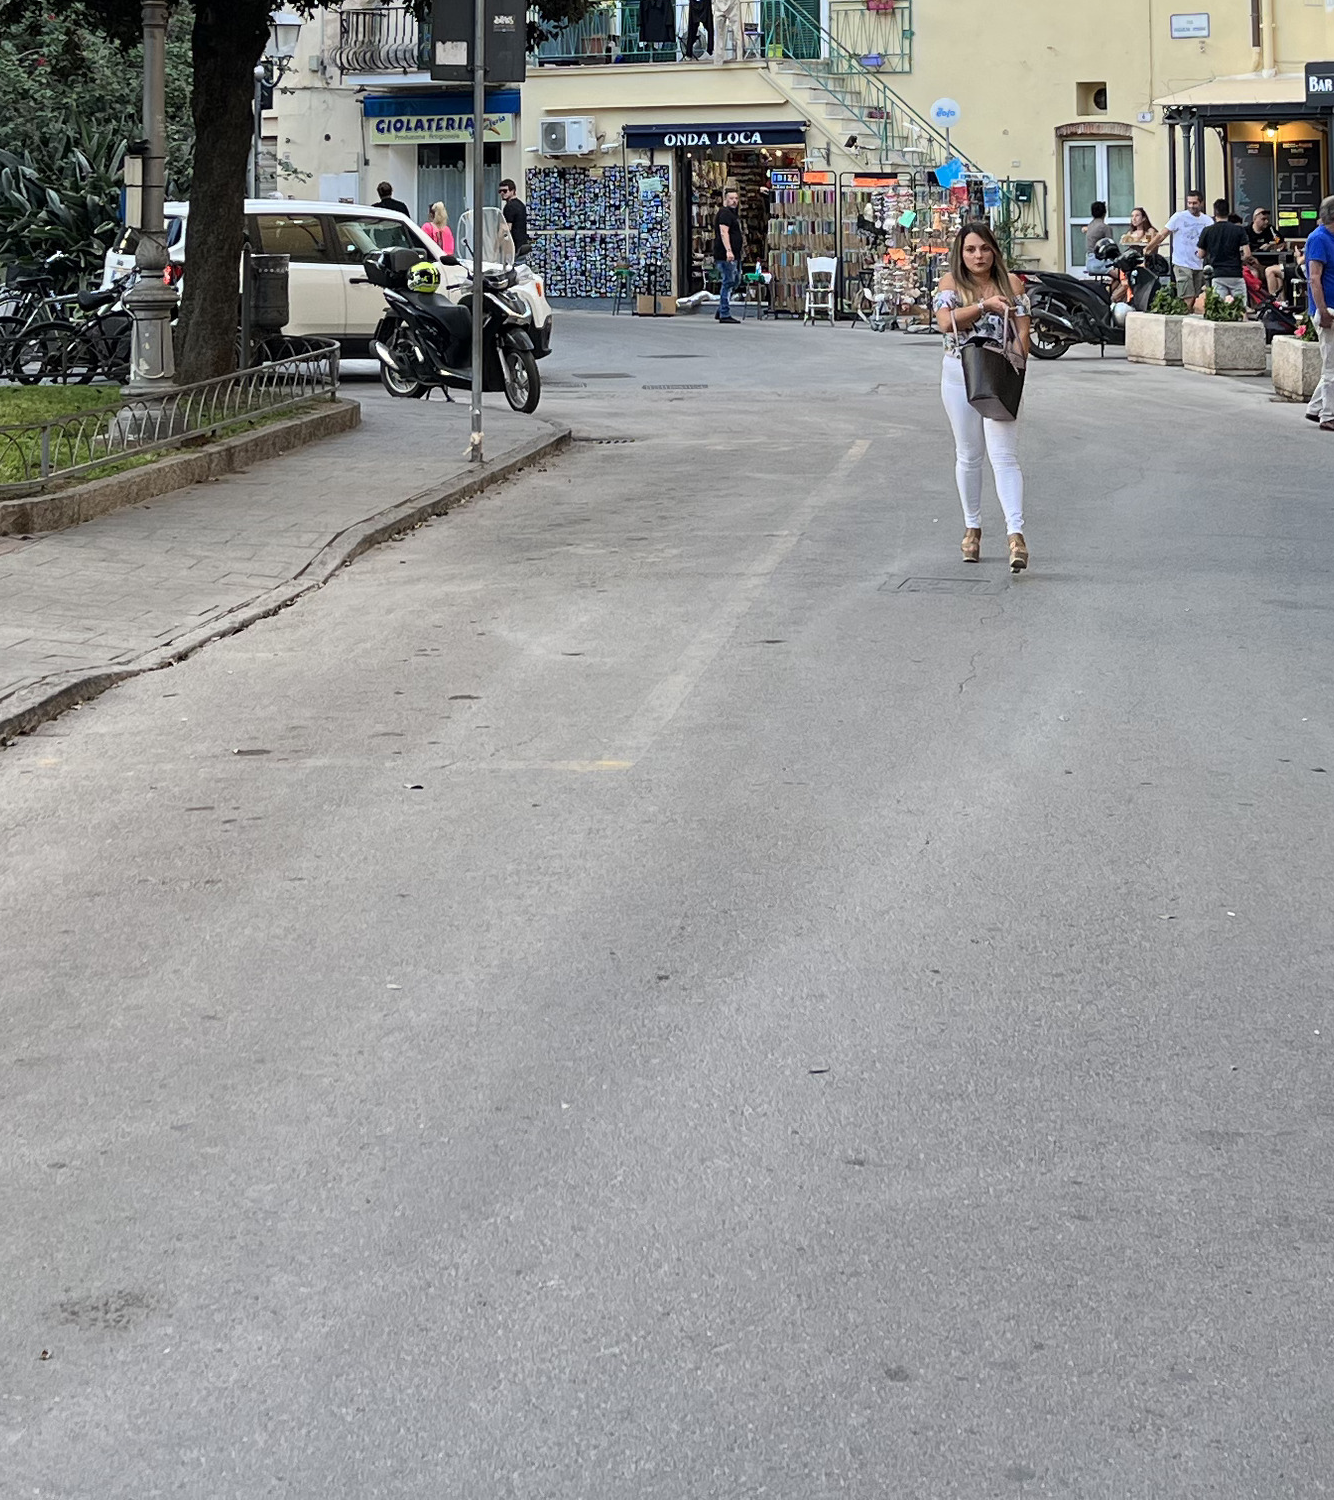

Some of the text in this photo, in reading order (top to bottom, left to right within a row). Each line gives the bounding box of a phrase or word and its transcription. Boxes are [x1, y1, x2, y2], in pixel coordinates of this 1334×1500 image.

[1309, 75, 1332, 92] Bar
[375, 116, 475, 134] GIOLATERIA
[664, 131, 763, 146] ONDA LOCA
